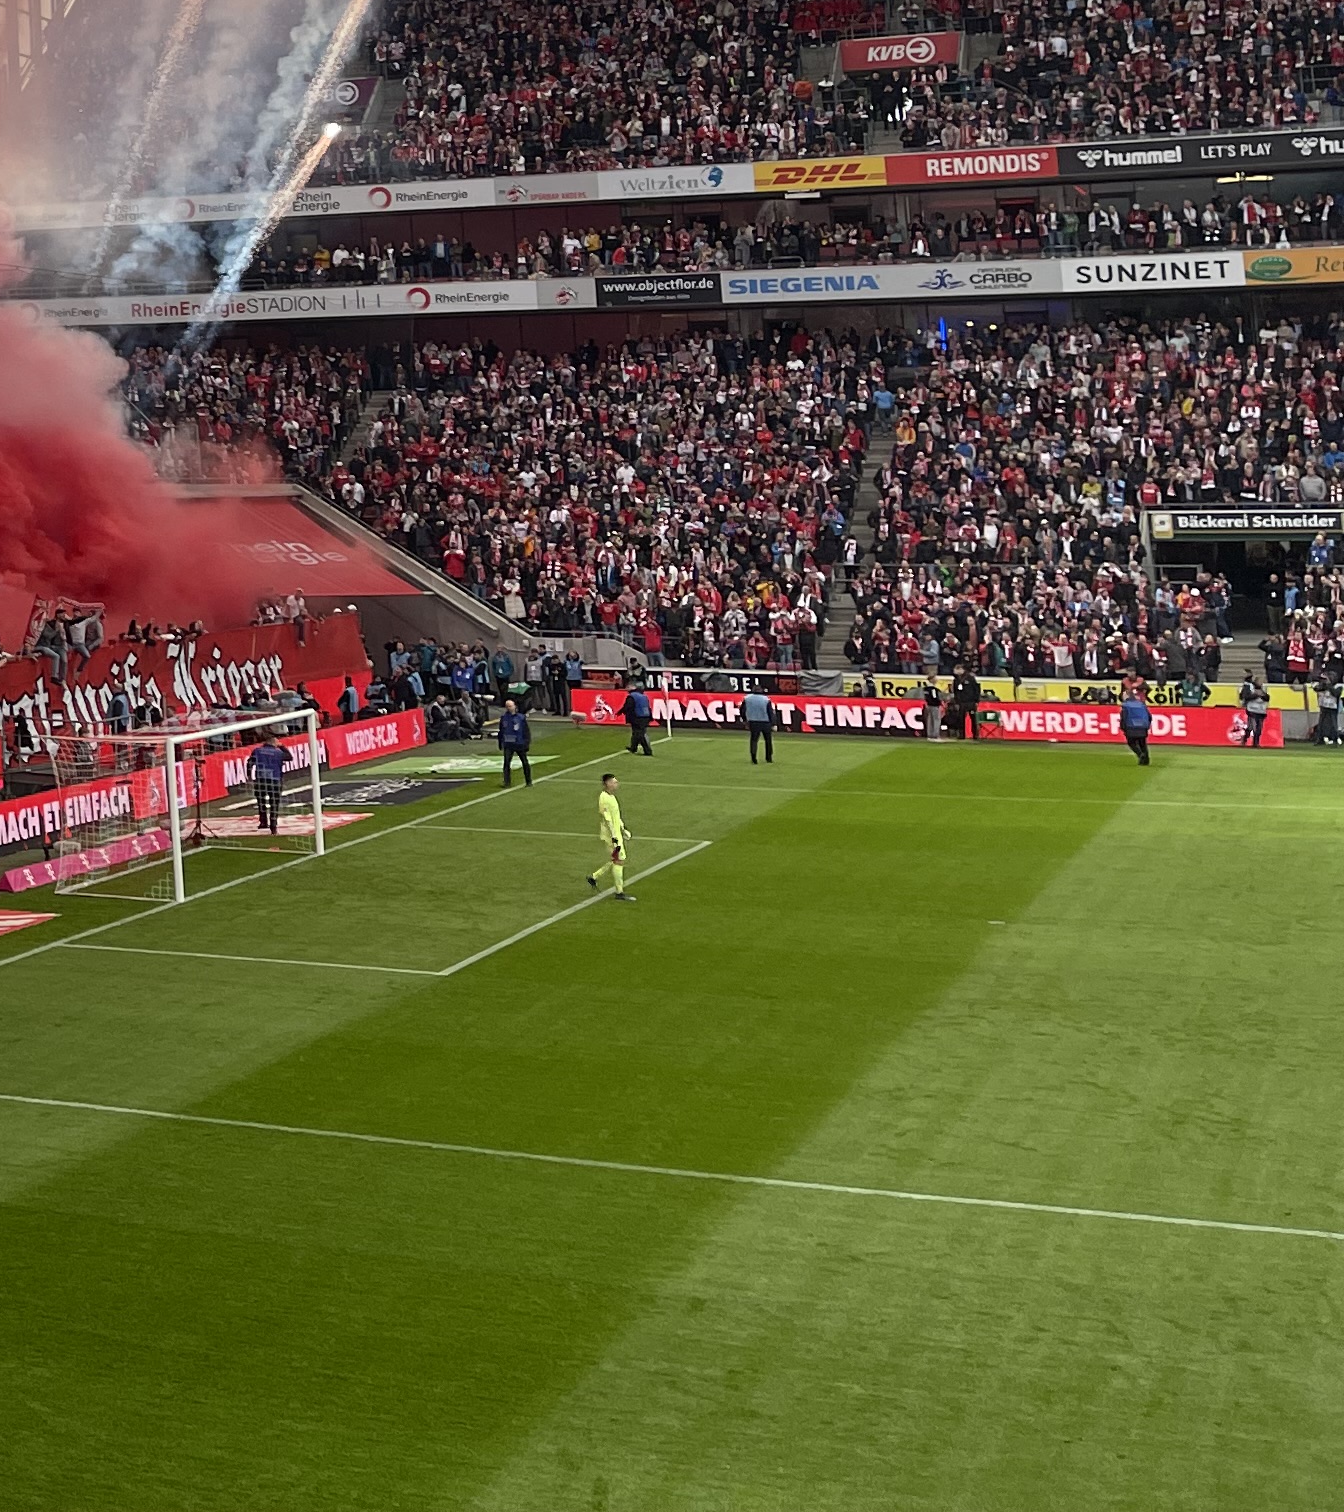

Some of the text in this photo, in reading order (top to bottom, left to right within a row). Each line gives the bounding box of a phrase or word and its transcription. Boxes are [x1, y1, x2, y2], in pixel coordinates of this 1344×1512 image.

[868, 45, 906, 62] KVB
[1104, 145, 1182, 167] hummel
[1200, 143, 1273, 160] LET'S PLAY
[620, 174, 699, 194] Weltzien
[771, 163, 869, 186] DHL
[292, 200, 340, 213] Energie
[297, 191, 332, 204] Rhein
[395, 189, 469, 204] RheinEnergie
[970, 272, 1032, 285] CARBO
[1076, 260, 1230, 284] SUNZINET
[603, 277, 714, 294] www.objectflor.de
[728, 275, 880, 296] SIEGENIA
[131, 296, 326, 319] RheinEngieSTADION
[435, 291, 509, 305] RheinEnergie
[1177, 512, 1336, 529] Bäckerei Schneider
[805, 703, 926, 730] EINFAC
[1000, 709, 1187, 737] WERDE-FDE
[346, 722, 398, 755] WERDE-FC.DE
[64, 785, 130, 828] EINFACH
